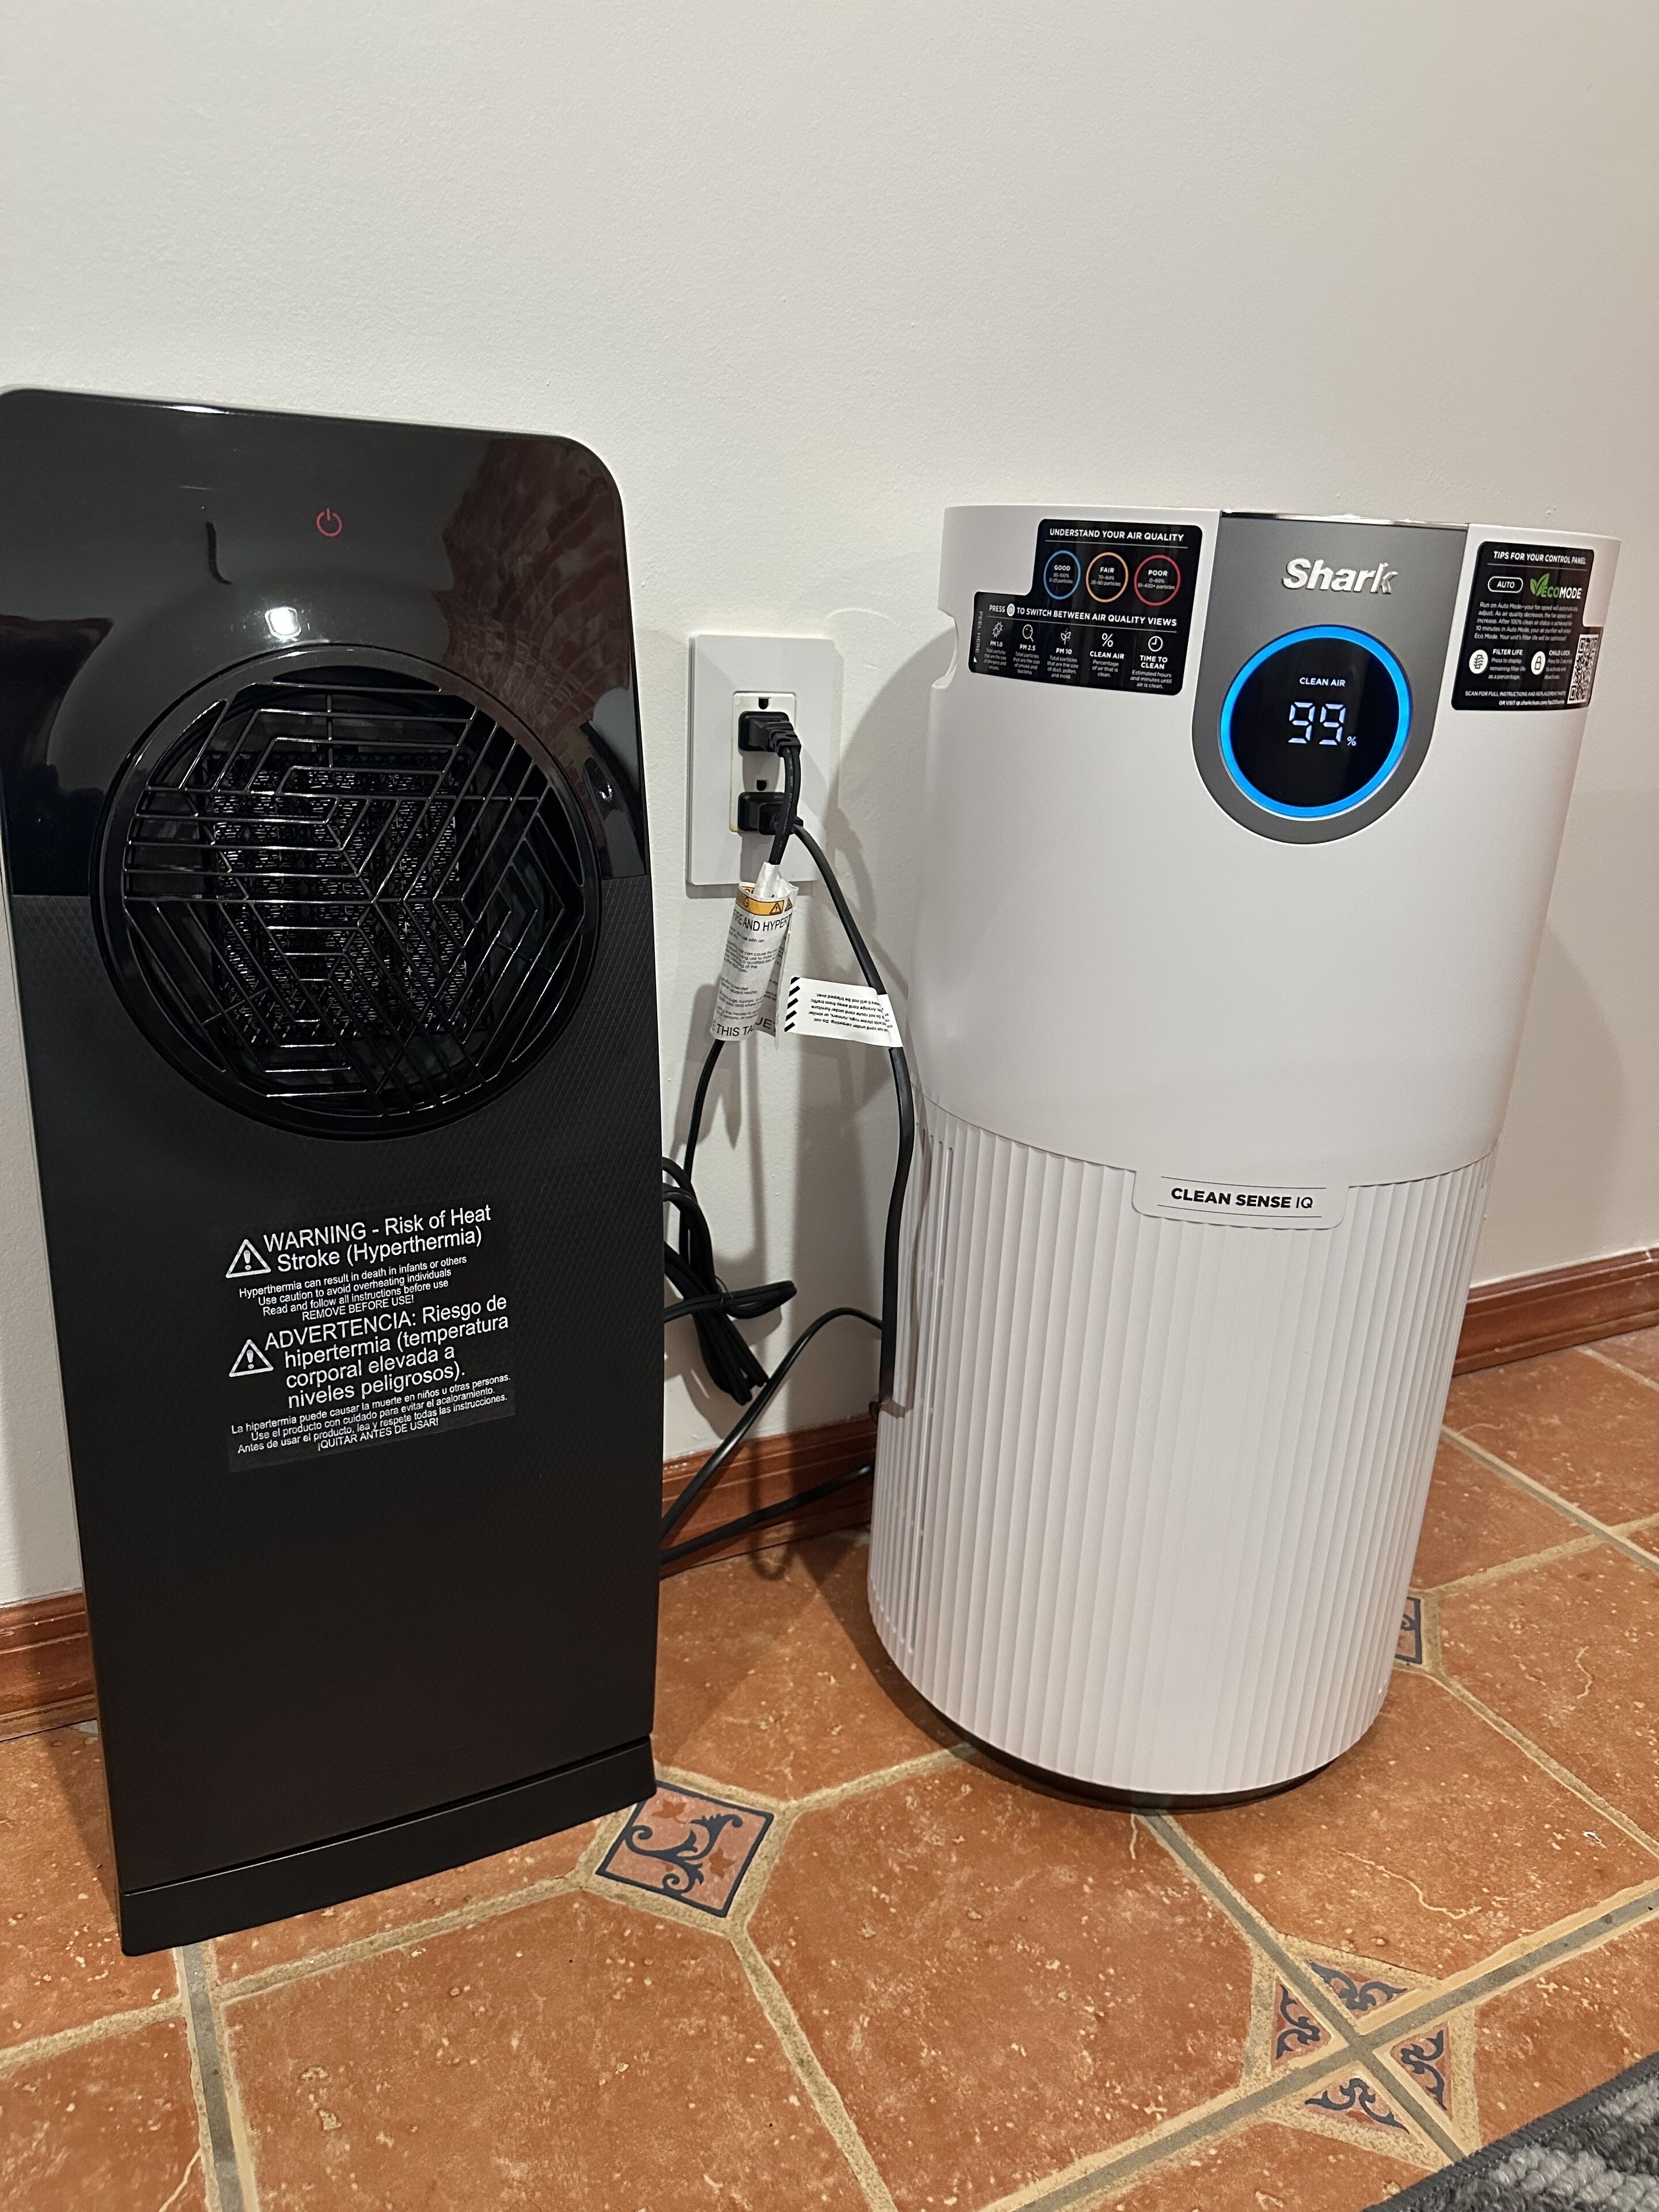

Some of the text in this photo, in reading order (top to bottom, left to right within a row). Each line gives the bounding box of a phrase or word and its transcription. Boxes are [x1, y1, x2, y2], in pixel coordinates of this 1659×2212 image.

[1050, 528, 1184, 541] UNDERSTAND YOUR AIR QUALITY
[1283, 558, 1398, 593] Shark
[1494, 551, 1509, 559] TIPS
[1510, 552, 1525, 560] FOR
[1527, 553, 1544, 561] YOUR
[1544, 555, 1570, 563] CONTROL
[989, 604, 1005, 612] PRESS
[1026, 608, 1052, 616] SWITCH
[1053, 610, 1090, 620] BETWEEN
[1092, 613, 1105, 621] AIR
[1108, 614, 1145, 624] QUALITY
[1147, 617, 1176, 626] VIEWS
[1299, 677, 1328, 685] CLEAN
[743, 918, 760, 931] AND
[717, 1023, 740, 1036] THIS
[1171, 1187, 1313, 1209] CLEAN SENSE IQ
[263, 1222, 366, 1252] WARNING
[385, 1214, 423, 1236] Risk
[429, 1210, 445, 1229] of
[450, 1204, 491, 1226] Heat
[278, 1225, 481, 1271] Stroke (Hyperthermia)
[239, 1256, 467, 1298] Hyperthermia can result in death in infants or others
[258, 1268, 451, 1308] Use caution to avoid overheating individuals
[263, 1280, 448, 1316] Read and follow all instructions before use
[302, 1294, 414, 1321] REMOVE BEFORE USE!
[265, 1296, 506, 1350] ADVERTENCIA: Riesgo de
[285, 1316, 508, 1369] hipertermia (temperatura
[286, 1346, 456, 1391] corporal elevada a
[288, 1361, 464, 1408] niveles peligrosos).
[231, 1425, 243, 1434] La
[245, 1415, 297, 1433] hipertermia
[299, 1410, 327, 1423] puede
[329, 1405, 359, 1416] causar
[362, 1402, 369, 1410] la
[372, 1396, 402, 1408] muerte
[404, 1394, 415, 1402] en
[417, 1389, 440, 1399] niños
[449, 1382, 469, 1393] otras
[472, 1374, 510, 1390] personas.
[251, 1387, 495, 1441] Use el producto con cuidado para evitar el acaloramiento.
[238, 1394, 507, 1453] Antes de usar el producto, lea y respete todas las instrucciones.
[318, 1417, 438, 1451] ¡QUITAR ANTES DE USAR!
